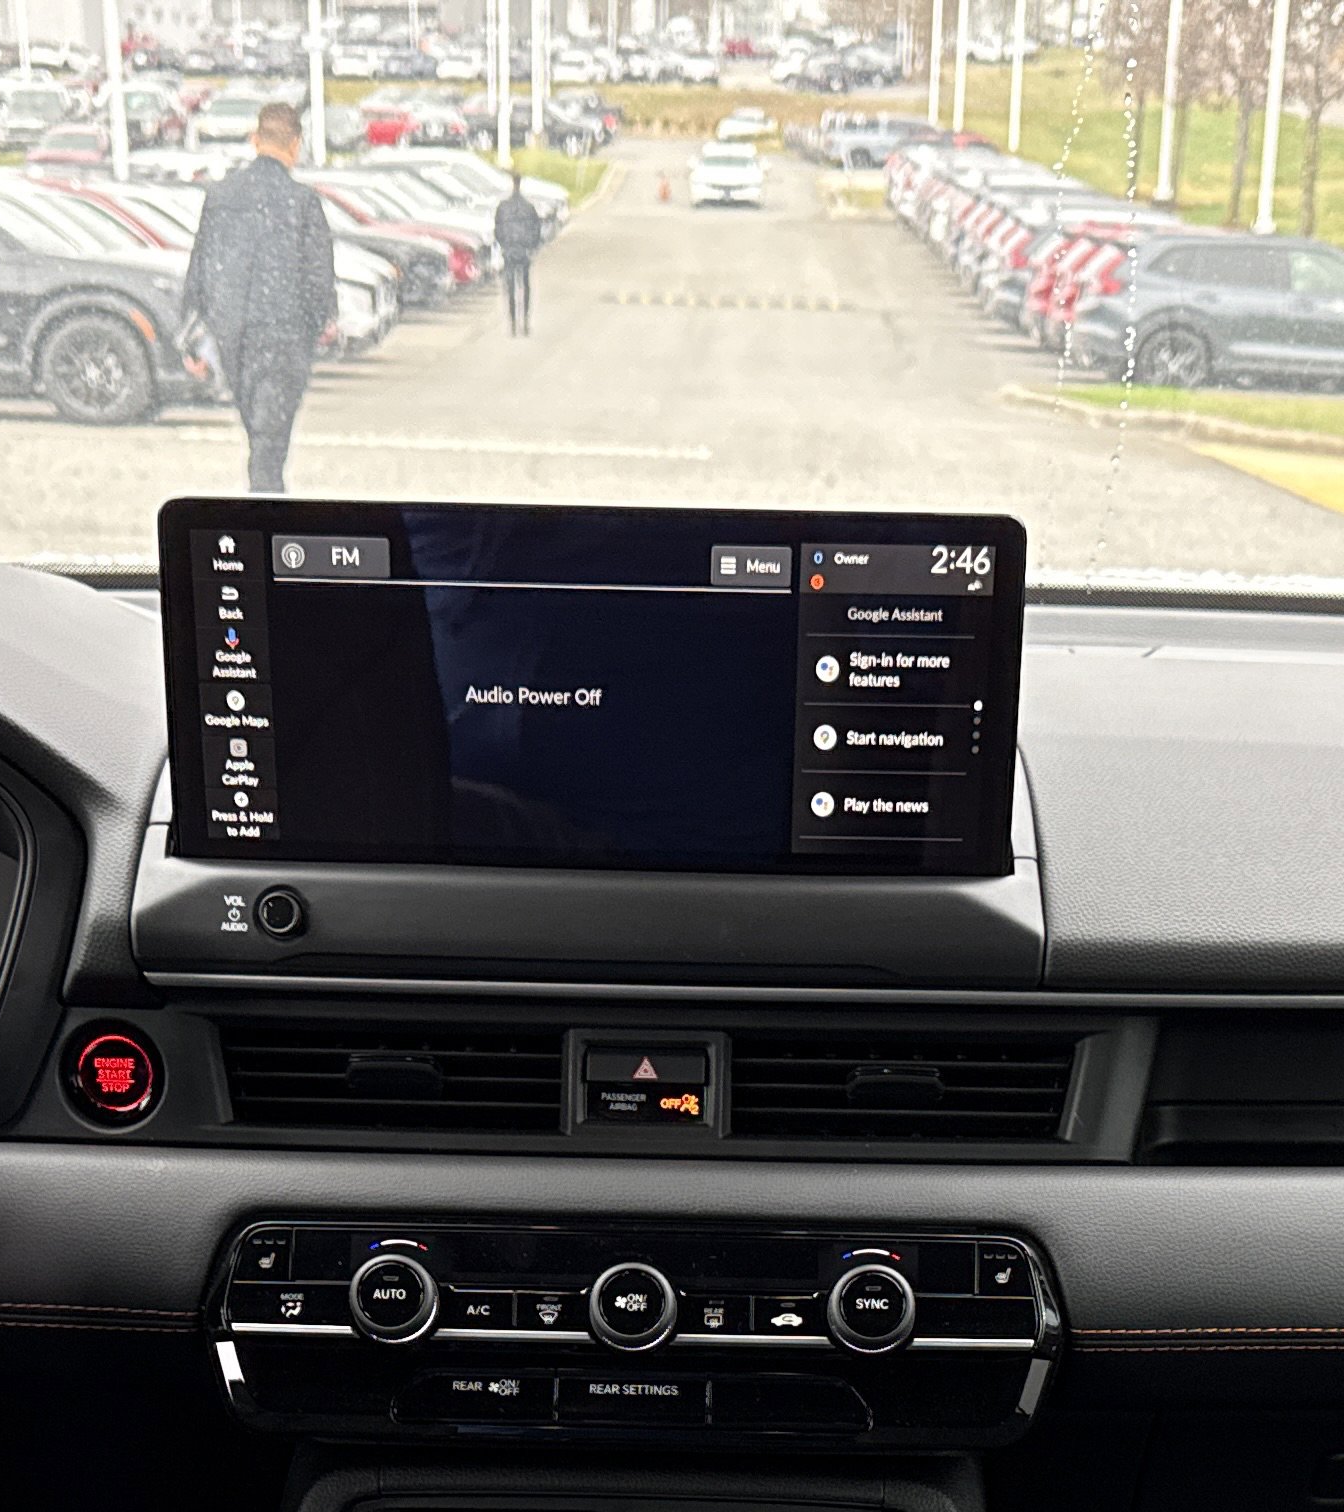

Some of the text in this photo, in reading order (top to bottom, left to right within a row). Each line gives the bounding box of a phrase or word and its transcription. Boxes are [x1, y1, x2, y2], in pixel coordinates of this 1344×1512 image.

[331, 546, 360, 566] FM
[834, 552, 869, 566] Owner
[931, 545, 991, 575] 2:46
[213, 558, 244, 571] Home
[746, 559, 781, 574] Menu
[218, 606, 244, 620] Back
[847, 607, 943, 623] Google Assistant
[216, 649, 251, 664] Google
[849, 651, 950, 670] Sign-in for more
[212, 665, 257, 678] Assistant
[848, 672, 900, 688] features
[465, 685, 602, 706] Audio Power Off
[205, 714, 269, 728] Google Maps
[846, 730, 944, 749] Start navigation
[225, 759, 254, 772] Apple
[222, 774, 259, 787] CarPlay
[843, 797, 929, 814] Play the news
[212, 809, 273, 823] Press & Hold
[227, 826, 260, 837] to Add
[223, 894, 247, 907] VOL
[221, 921, 248, 932] AUDIO
[94, 1057, 135, 1069] ENGINE
[98, 1068, 132, 1079] START
[101, 1082, 130, 1092] STOP
[601, 1092, 646, 1102] PASSENGER
[660, 1098, 682, 1110] OFF
[280, 1293, 304, 1301] MODE
[372, 1288, 406, 1301] AUTO
[466, 1304, 491, 1316] A/C
[536, 1303, 562, 1311] FRONT
[627, 1302, 648, 1312] OFF
[855, 1298, 889, 1310] SYNC
[452, 1380, 482, 1391] REAR
[499, 1387, 520, 1396] OFF
[589, 1383, 679, 1396] REAR SETTINGS
